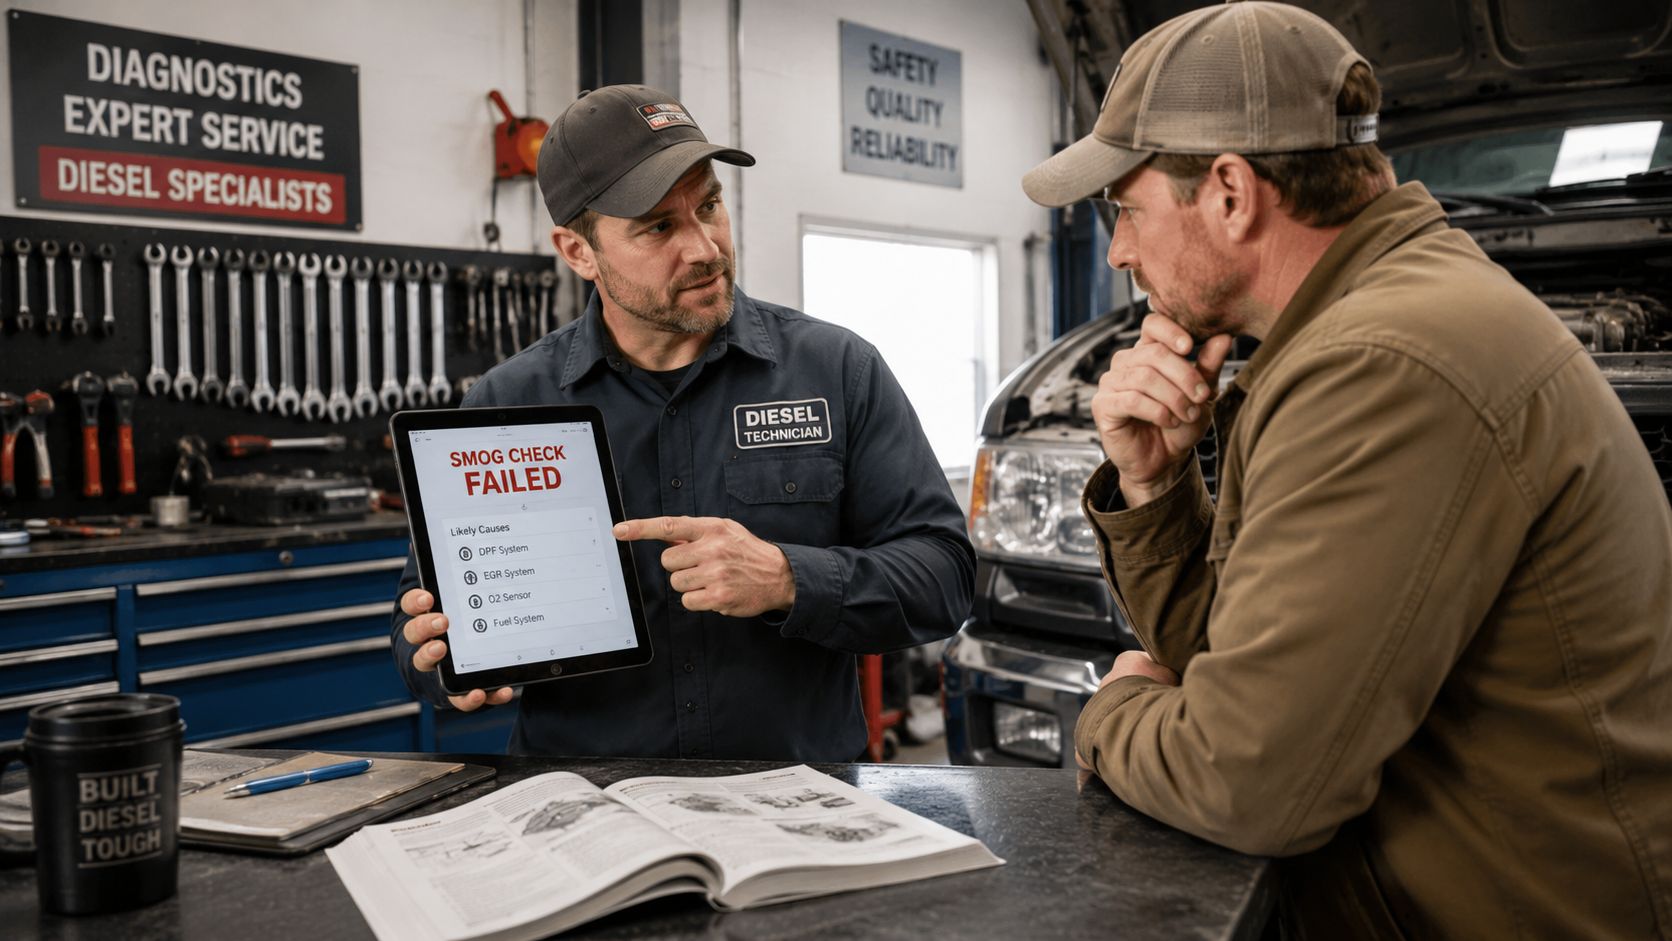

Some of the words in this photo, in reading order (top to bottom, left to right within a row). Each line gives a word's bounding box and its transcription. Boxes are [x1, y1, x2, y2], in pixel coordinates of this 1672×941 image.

[87, 42, 303, 110] DIAGNOSTICS
[868, 43, 939, 86] SAFETY
[865, 85, 944, 128] QUALITY
[63, 94, 193, 145] EXPERT
[201, 111, 324, 160] SERVICE
[851, 126, 958, 172] RELIABILITY
[57, 158, 160, 199] DIESEL
[167, 168, 333, 214] SPECIALISTS
[745, 406, 820, 427] DIESEL
[744, 426, 823, 443] TECHNICIAN
[450, 449, 504, 468] SMOG
[508, 445, 566, 463] CHECK
[464, 466, 562, 496] FAILED
[450, 526, 476, 537] Likely
[478, 524, 510, 534] Causes
[479, 546, 497, 556] DPF
[498, 544, 529, 556] System
[483, 570, 502, 580] EGR
[504, 567, 535, 579] System
[502, 591, 531, 602] Sensor
[493, 617, 512, 627] Fuel
[513, 614, 545, 626] System
[80, 770, 159, 803] BUILT
[80, 801, 160, 833] DIESEL
[81, 829, 160, 861] TOUGH
